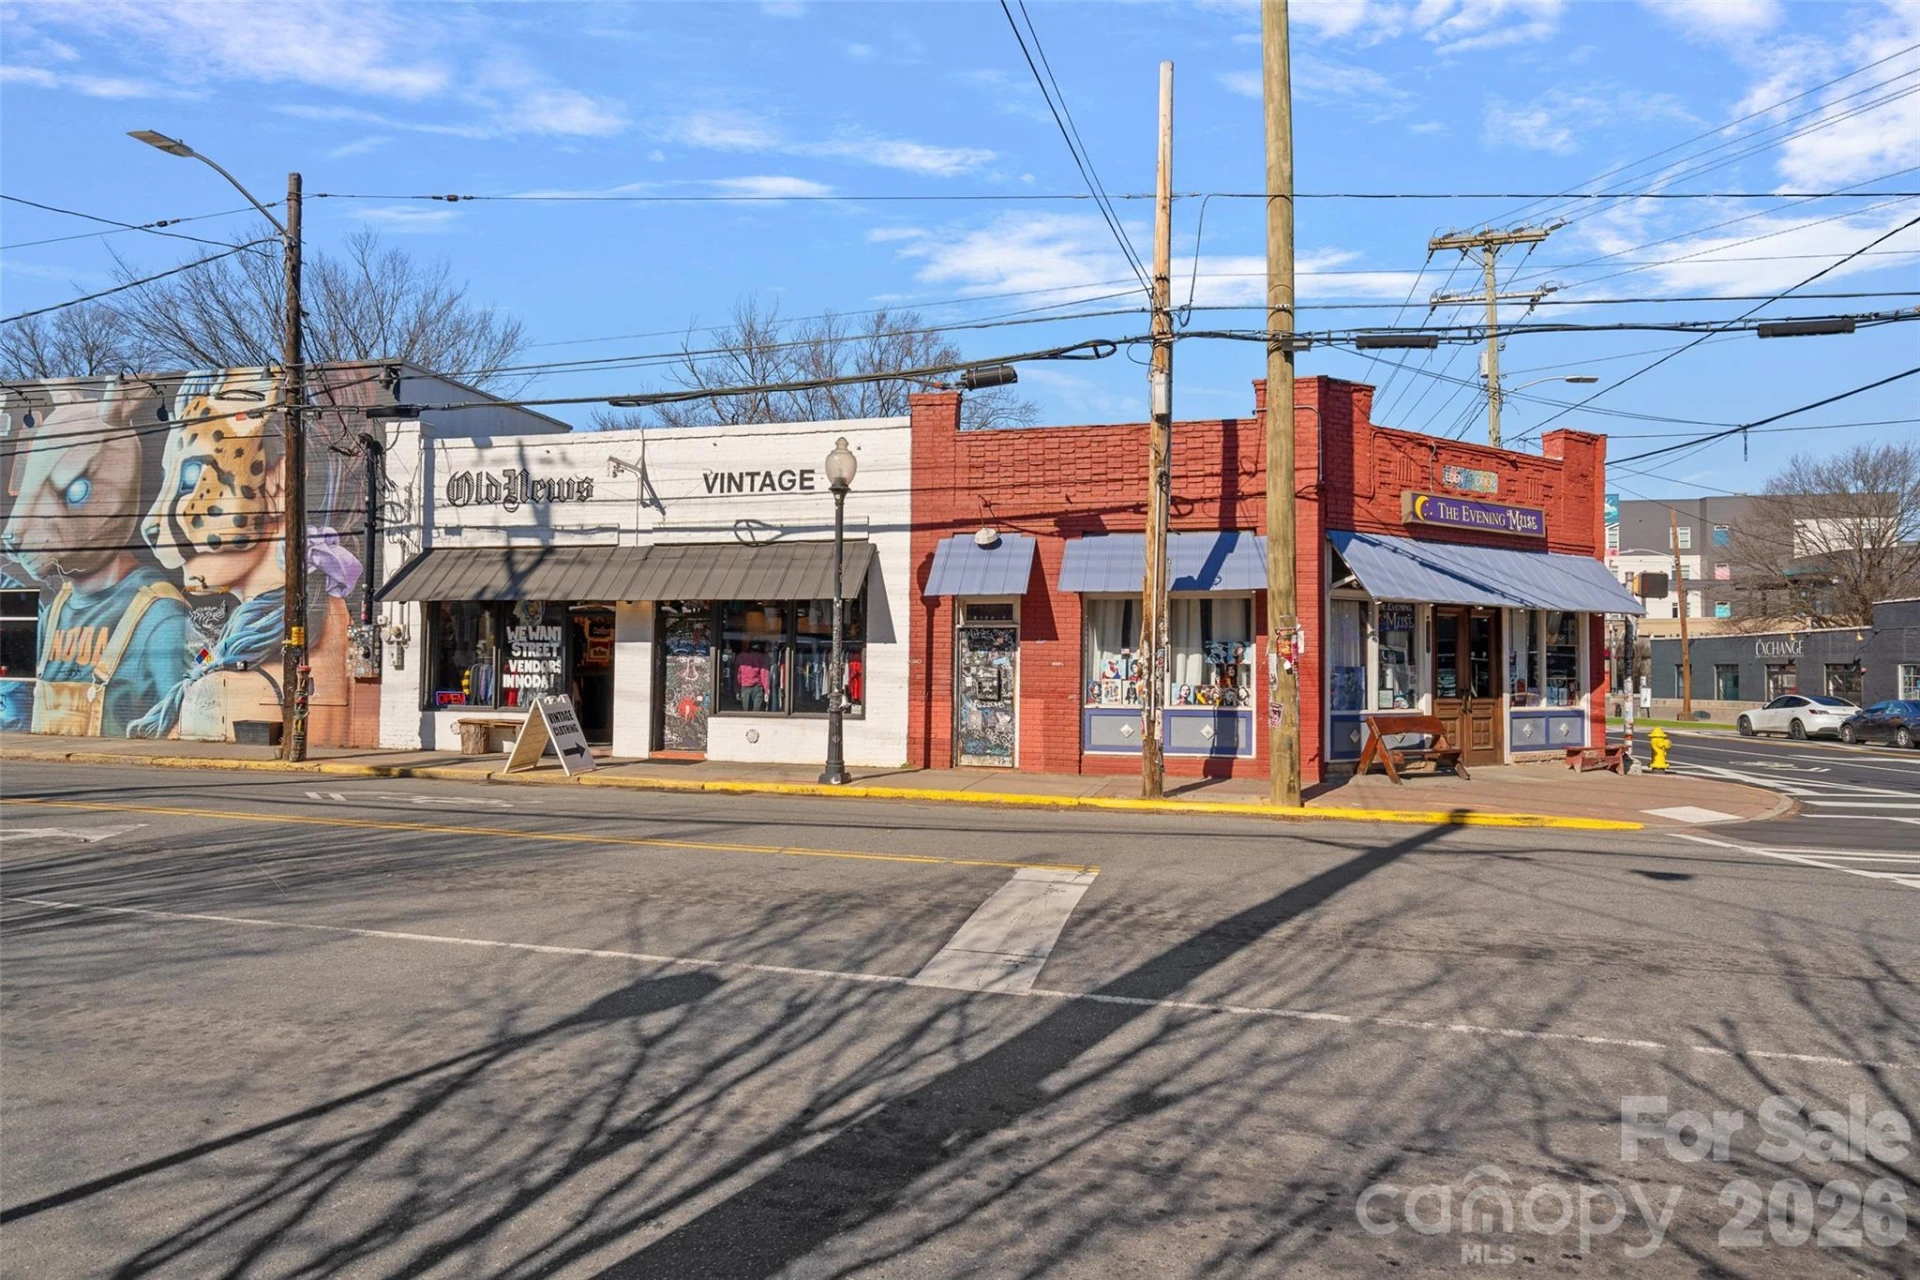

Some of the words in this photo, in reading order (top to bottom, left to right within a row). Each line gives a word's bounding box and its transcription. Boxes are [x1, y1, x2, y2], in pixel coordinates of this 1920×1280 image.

[703, 469, 815, 494] VINTAGE
[1437, 502, 1460, 520] THE
[506, 626, 527, 641] WE
[511, 642, 560, 657] STREET
[508, 659, 562, 674] VENDORS
[439, 693, 465, 704] OPEN
[547, 710, 574, 724] VINTAGE
